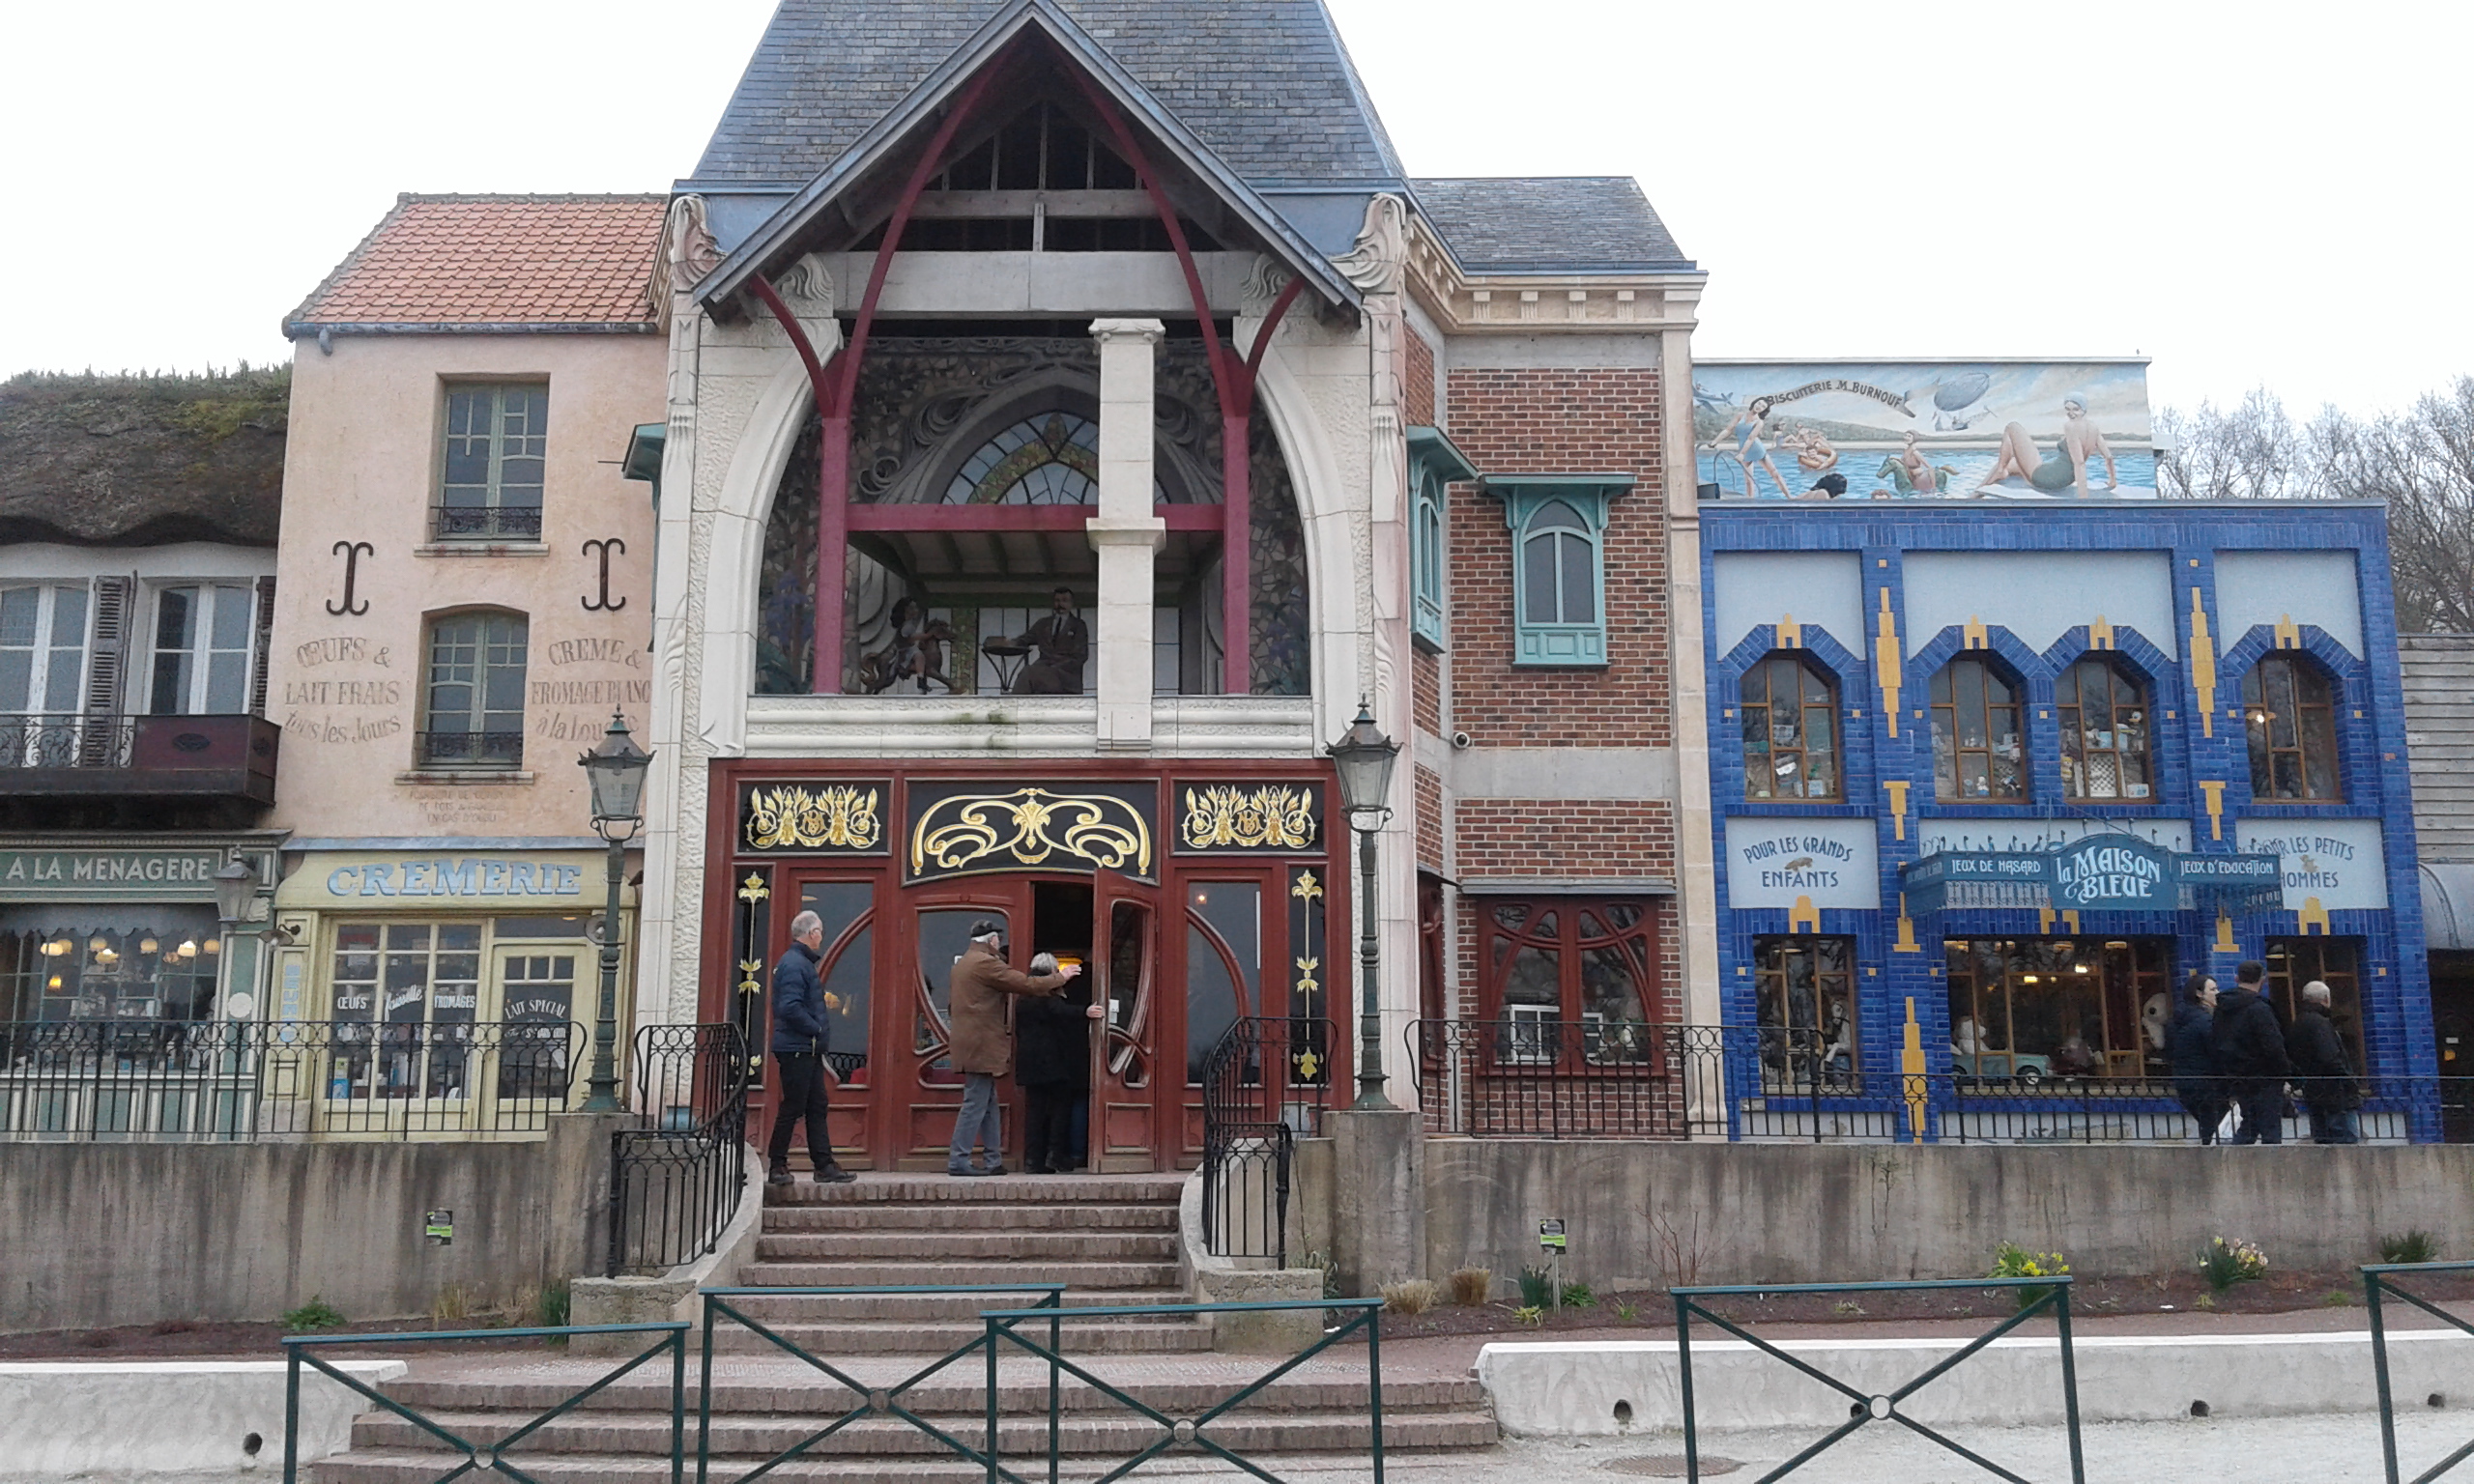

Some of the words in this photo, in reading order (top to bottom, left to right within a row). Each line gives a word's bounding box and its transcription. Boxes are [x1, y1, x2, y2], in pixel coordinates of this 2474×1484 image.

[1853, 382, 1902, 408] BURNOUF
[373, 646, 390, 668] &
[548, 638, 624, 666] CREME
[624, 649, 642, 669] &
[285, 681, 331, 705] LAIT
[337, 680, 400, 705] FRAIS
[532, 680, 603, 704] FROMAGE
[321, 716, 347, 743] les
[548, 712, 567, 739] la
[442, 813, 458, 823] CAS
[1742, 840, 1778, 864] POUR
[1779, 837, 1798, 854] LES
[1803, 836, 1854, 862] GRANDS
[2289, 837, 2310, 854] LES
[2316, 837, 2355, 861] PETITS
[6, 856, 25, 880] A
[34, 856, 62, 880] LA
[72, 857, 211, 881] MENAGERE
[327, 858, 580, 896] CREMERIE
[1762, 870, 1839, 888] ENFANTS
[1951, 859, 1977, 874] JEUX
[1980, 859, 1995, 872] DE
[1999, 860, 2041, 875] HASARD
[2056, 857, 2073, 874] la
[2065, 845, 2161, 899] MAISON
[2180, 860, 2205, 876] JEUX
[2078, 874, 2152, 903] BLEUE
[434, 995, 475, 1009] FROMAGES
[504, 1000, 526, 1020] LAIT
